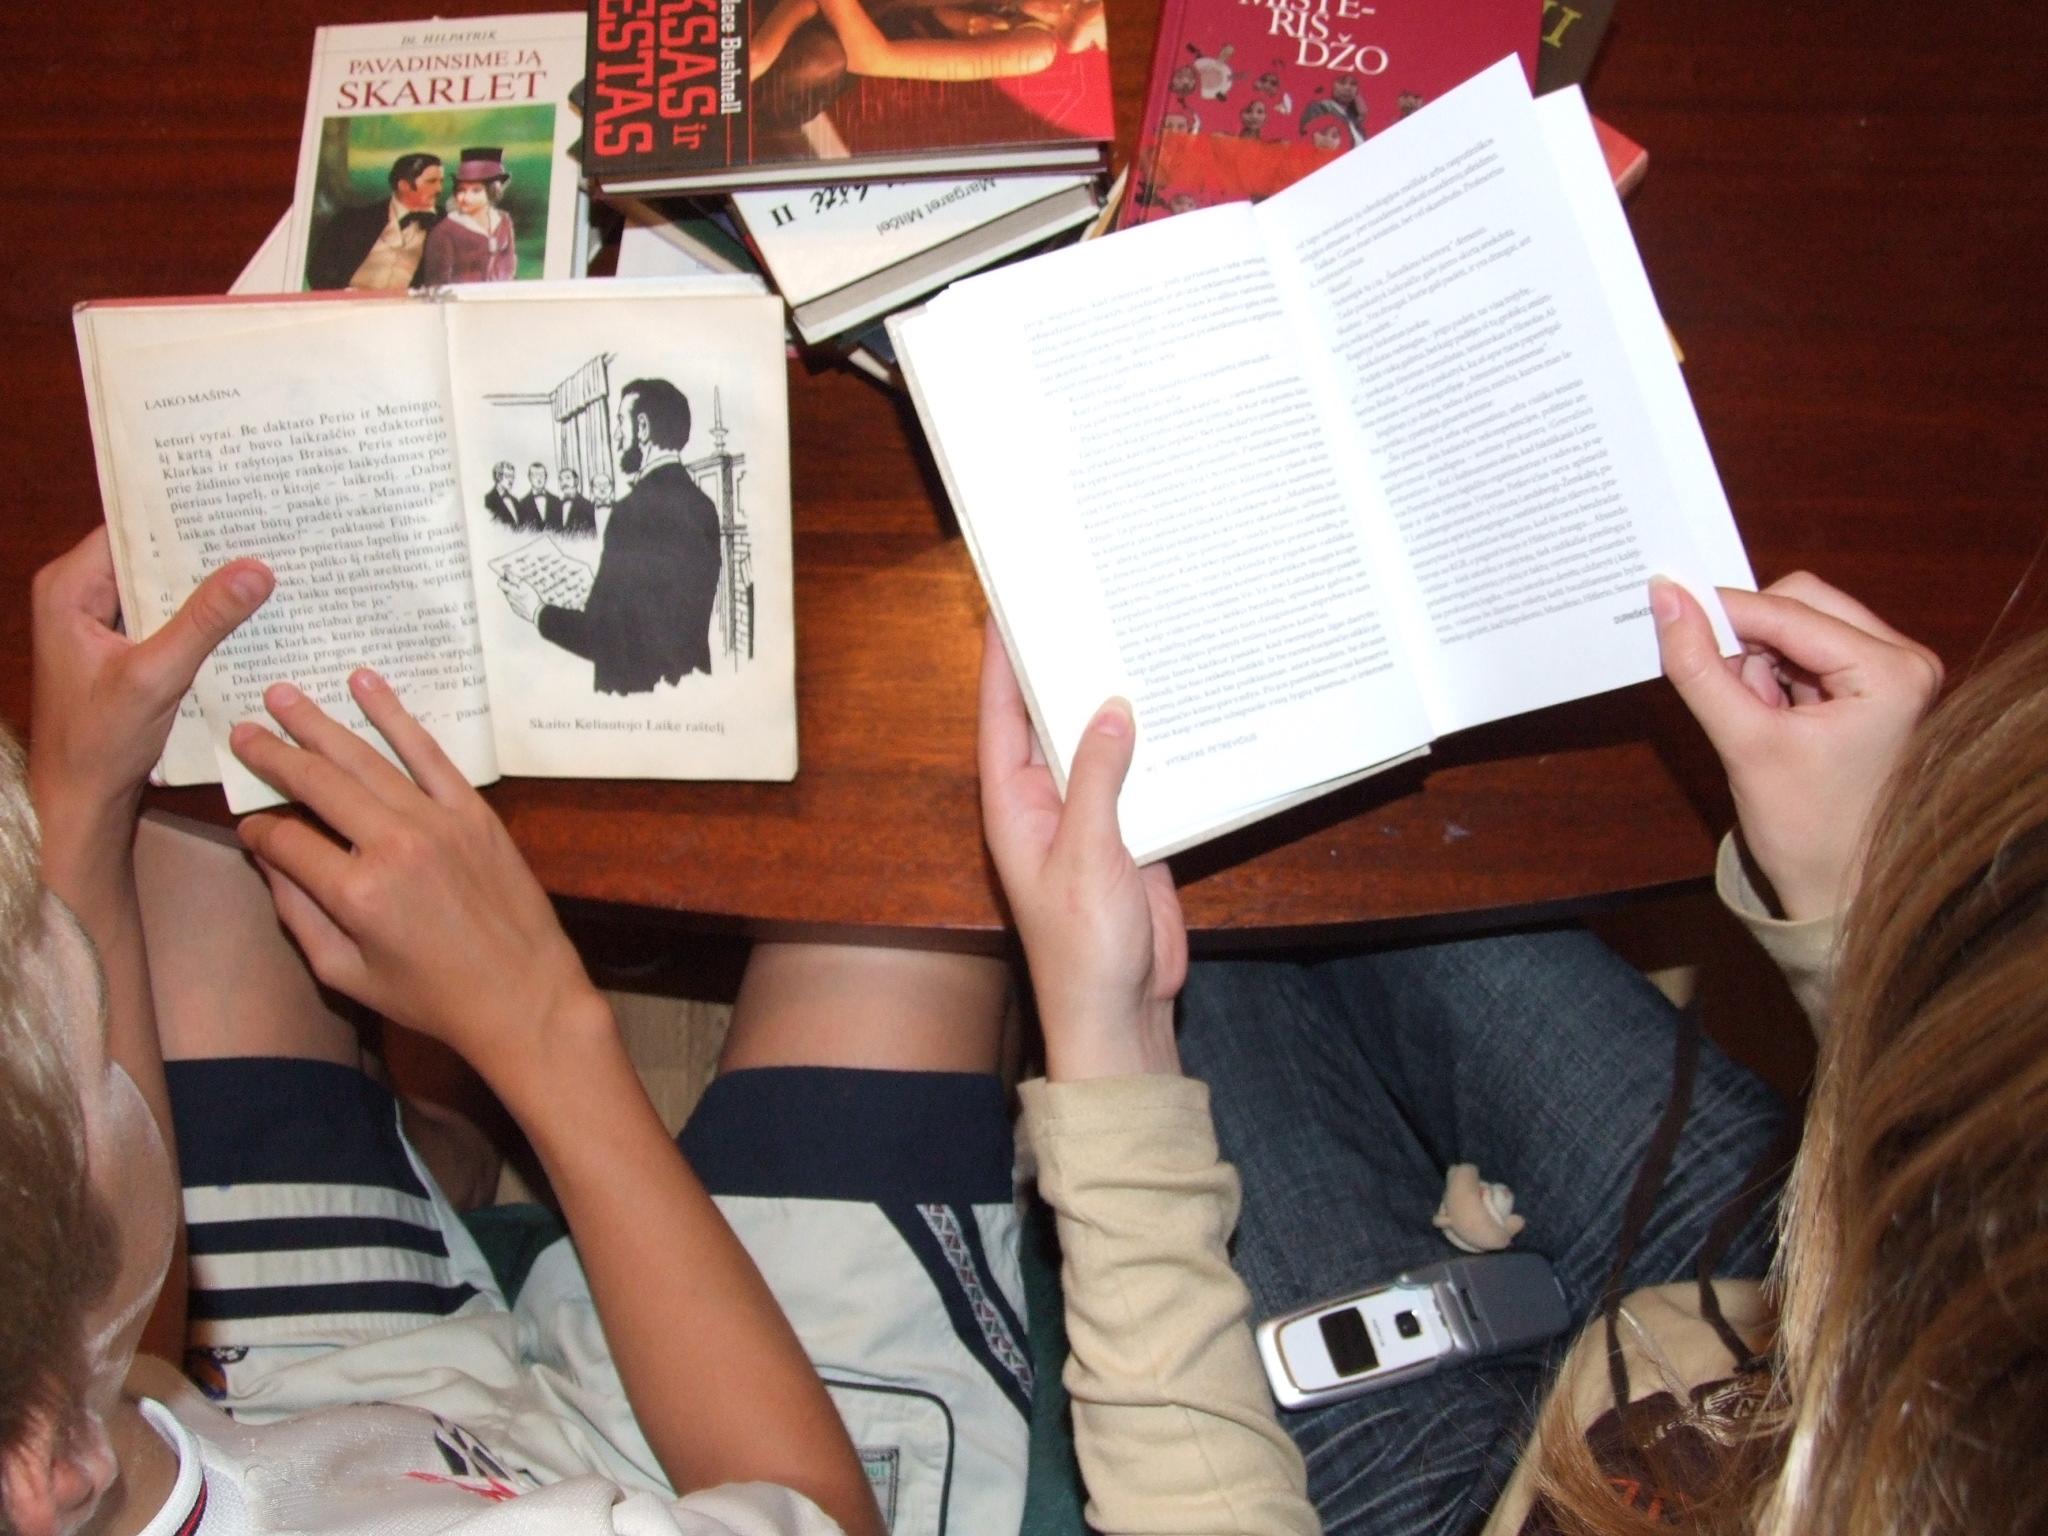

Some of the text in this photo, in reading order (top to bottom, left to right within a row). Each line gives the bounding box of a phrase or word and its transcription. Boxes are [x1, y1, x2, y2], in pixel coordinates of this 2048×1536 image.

[1267, 7, 1330, 41] RIS
[349, 48, 545, 75] PAVADINSIME JĄ
[1296, 33, 1389, 76] DŽO
[336, 69, 549, 110] SKARLET
[720, 36, 742, 115] Bushnell
[672, 121, 708, 150] ir
[925, 176, 998, 214] Margaret
[144, 387, 241, 411] LAIKO MAŠINA
[154, 435, 194, 449] keturi
[240, 425, 258, 436] Be
[262, 419, 314, 433] daktaro
[319, 413, 354, 425] Perio
[360, 410, 370, 420] ir
[376, 401, 441, 417] Meningo,
[177, 449, 212, 461] kartą
[219, 445, 240, 455] dar
[249, 440, 282, 450] buvo
[290, 428, 356, 446] laikraščio
[364, 415, 444, 435] redaktorius
[162, 465, 213, 480] Klarkas
[218, 463, 228, 472] ir
[234, 454, 294, 470] rašytojas
[358, 440, 392, 452] Peris
[398, 430, 447, 446] stovėjo
[166, 485, 191, 499] prie
[196, 477, 240, 491] židinio
[243, 469, 290, 485] vienoje
[295, 462, 344, 477] rankoje
[348, 452, 424, 470] laikydamas
[428, 478, 456, 493] pats
[170, 497, 222, 514] pieriaus
[270, 489, 280, 497] o
[282, 481, 320, 495] kitoje
[177, 528, 216, 542] laikas
[220, 522, 256, 535] dabar
[296, 509, 342, 527] pradėti
[330, 518, 385, 537] paklausė
[299, 539, 364, 556] popieriaus
[366, 532, 409, 547] lapeliu
[413, 530, 422, 540] ir
[309, 555, 347, 572] paliko
[310, 571, 332, 583] kad
[348, 567, 370, 581] gali
[435, 559, 444, 568] ir
[289, 605, 314, 619] prie
[318, 599, 348, 612] stalo
[352, 597, 366, 608] be
[298, 587, 329, 600] laiku
[307, 614, 352, 629] nelabai
[211, 642, 270, 656] daktorius
[331, 628, 365, 641] kurio
[370, 621, 418, 636] išvaizda
[214, 662, 228, 676] jis
[233, 652, 309, 671] nepraleidžia
[314, 646, 356, 661] progos
[361, 639, 392, 655] gerai
[232, 671, 288, 686] Daktaras
[371, 649, 436, 666] vakarienės
[222, 693, 230, 702] ir
[316, 677, 342, 690] prie
[394, 666, 439, 679] ovalaus
[442, 661, 472, 674] stalo
[528, 716, 571, 730] Skaito
[574, 716, 642, 733] Keliautojo
[646, 718, 682, 732] Laike
